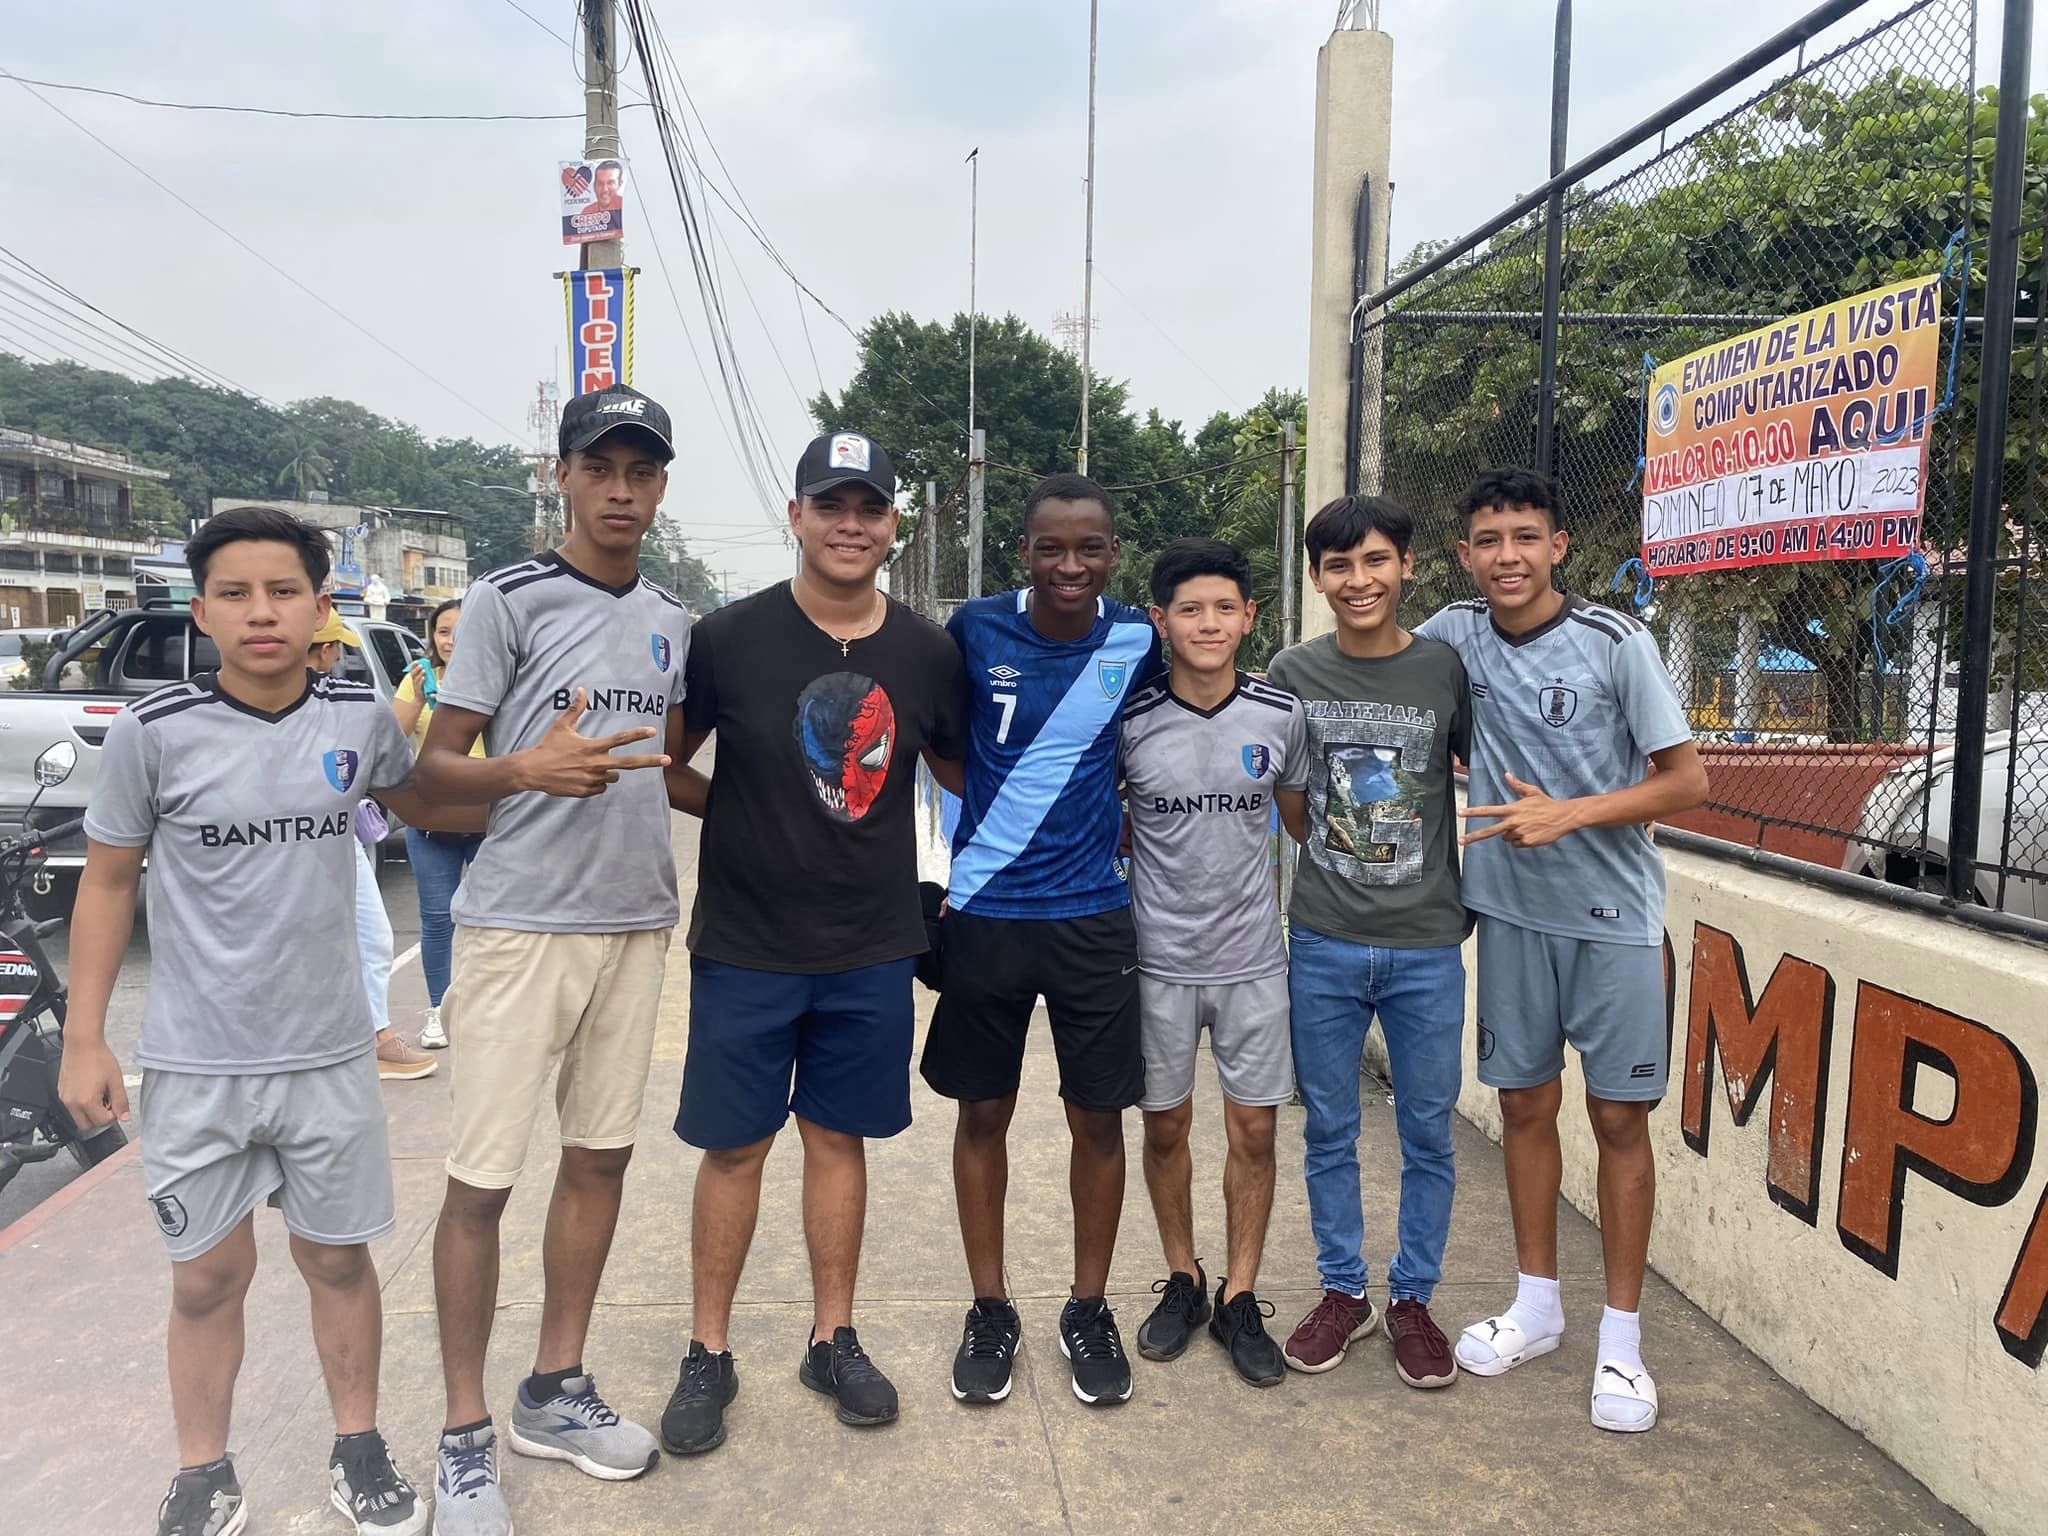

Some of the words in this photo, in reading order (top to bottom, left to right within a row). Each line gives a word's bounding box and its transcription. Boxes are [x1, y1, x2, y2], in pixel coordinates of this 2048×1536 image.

[1682, 335, 1764, 394] EXAMEN
[1765, 323, 1799, 366] DE
[1804, 312, 1835, 355] LA
[1848, 283, 1937, 343] VISTA
[1694, 345, 1899, 430] COMPUTARIZADO
[1810, 388, 1927, 456] AQUI
[1649, 437, 1706, 491] VALOR
[1711, 422, 1794, 476] Q.10.00
[1737, 474, 1764, 522] 07
[1769, 478, 1786, 505] DE
[1791, 457, 1856, 514] MAYO
[1871, 466, 1920, 496] 2023
[1715, 536, 1735, 559] DE
[1781, 525, 1809, 553] AM
[1815, 523, 1827, 551] A
[1830, 520, 1876, 549] 4:00
[1881, 516, 1920, 547] PM
[990, 679, 1017, 688] umbro
[992, 693, 1017, 744] 7
[200, 812, 348, 847] BANTRAB
[1154, 793, 1262, 815] BANTRAB
